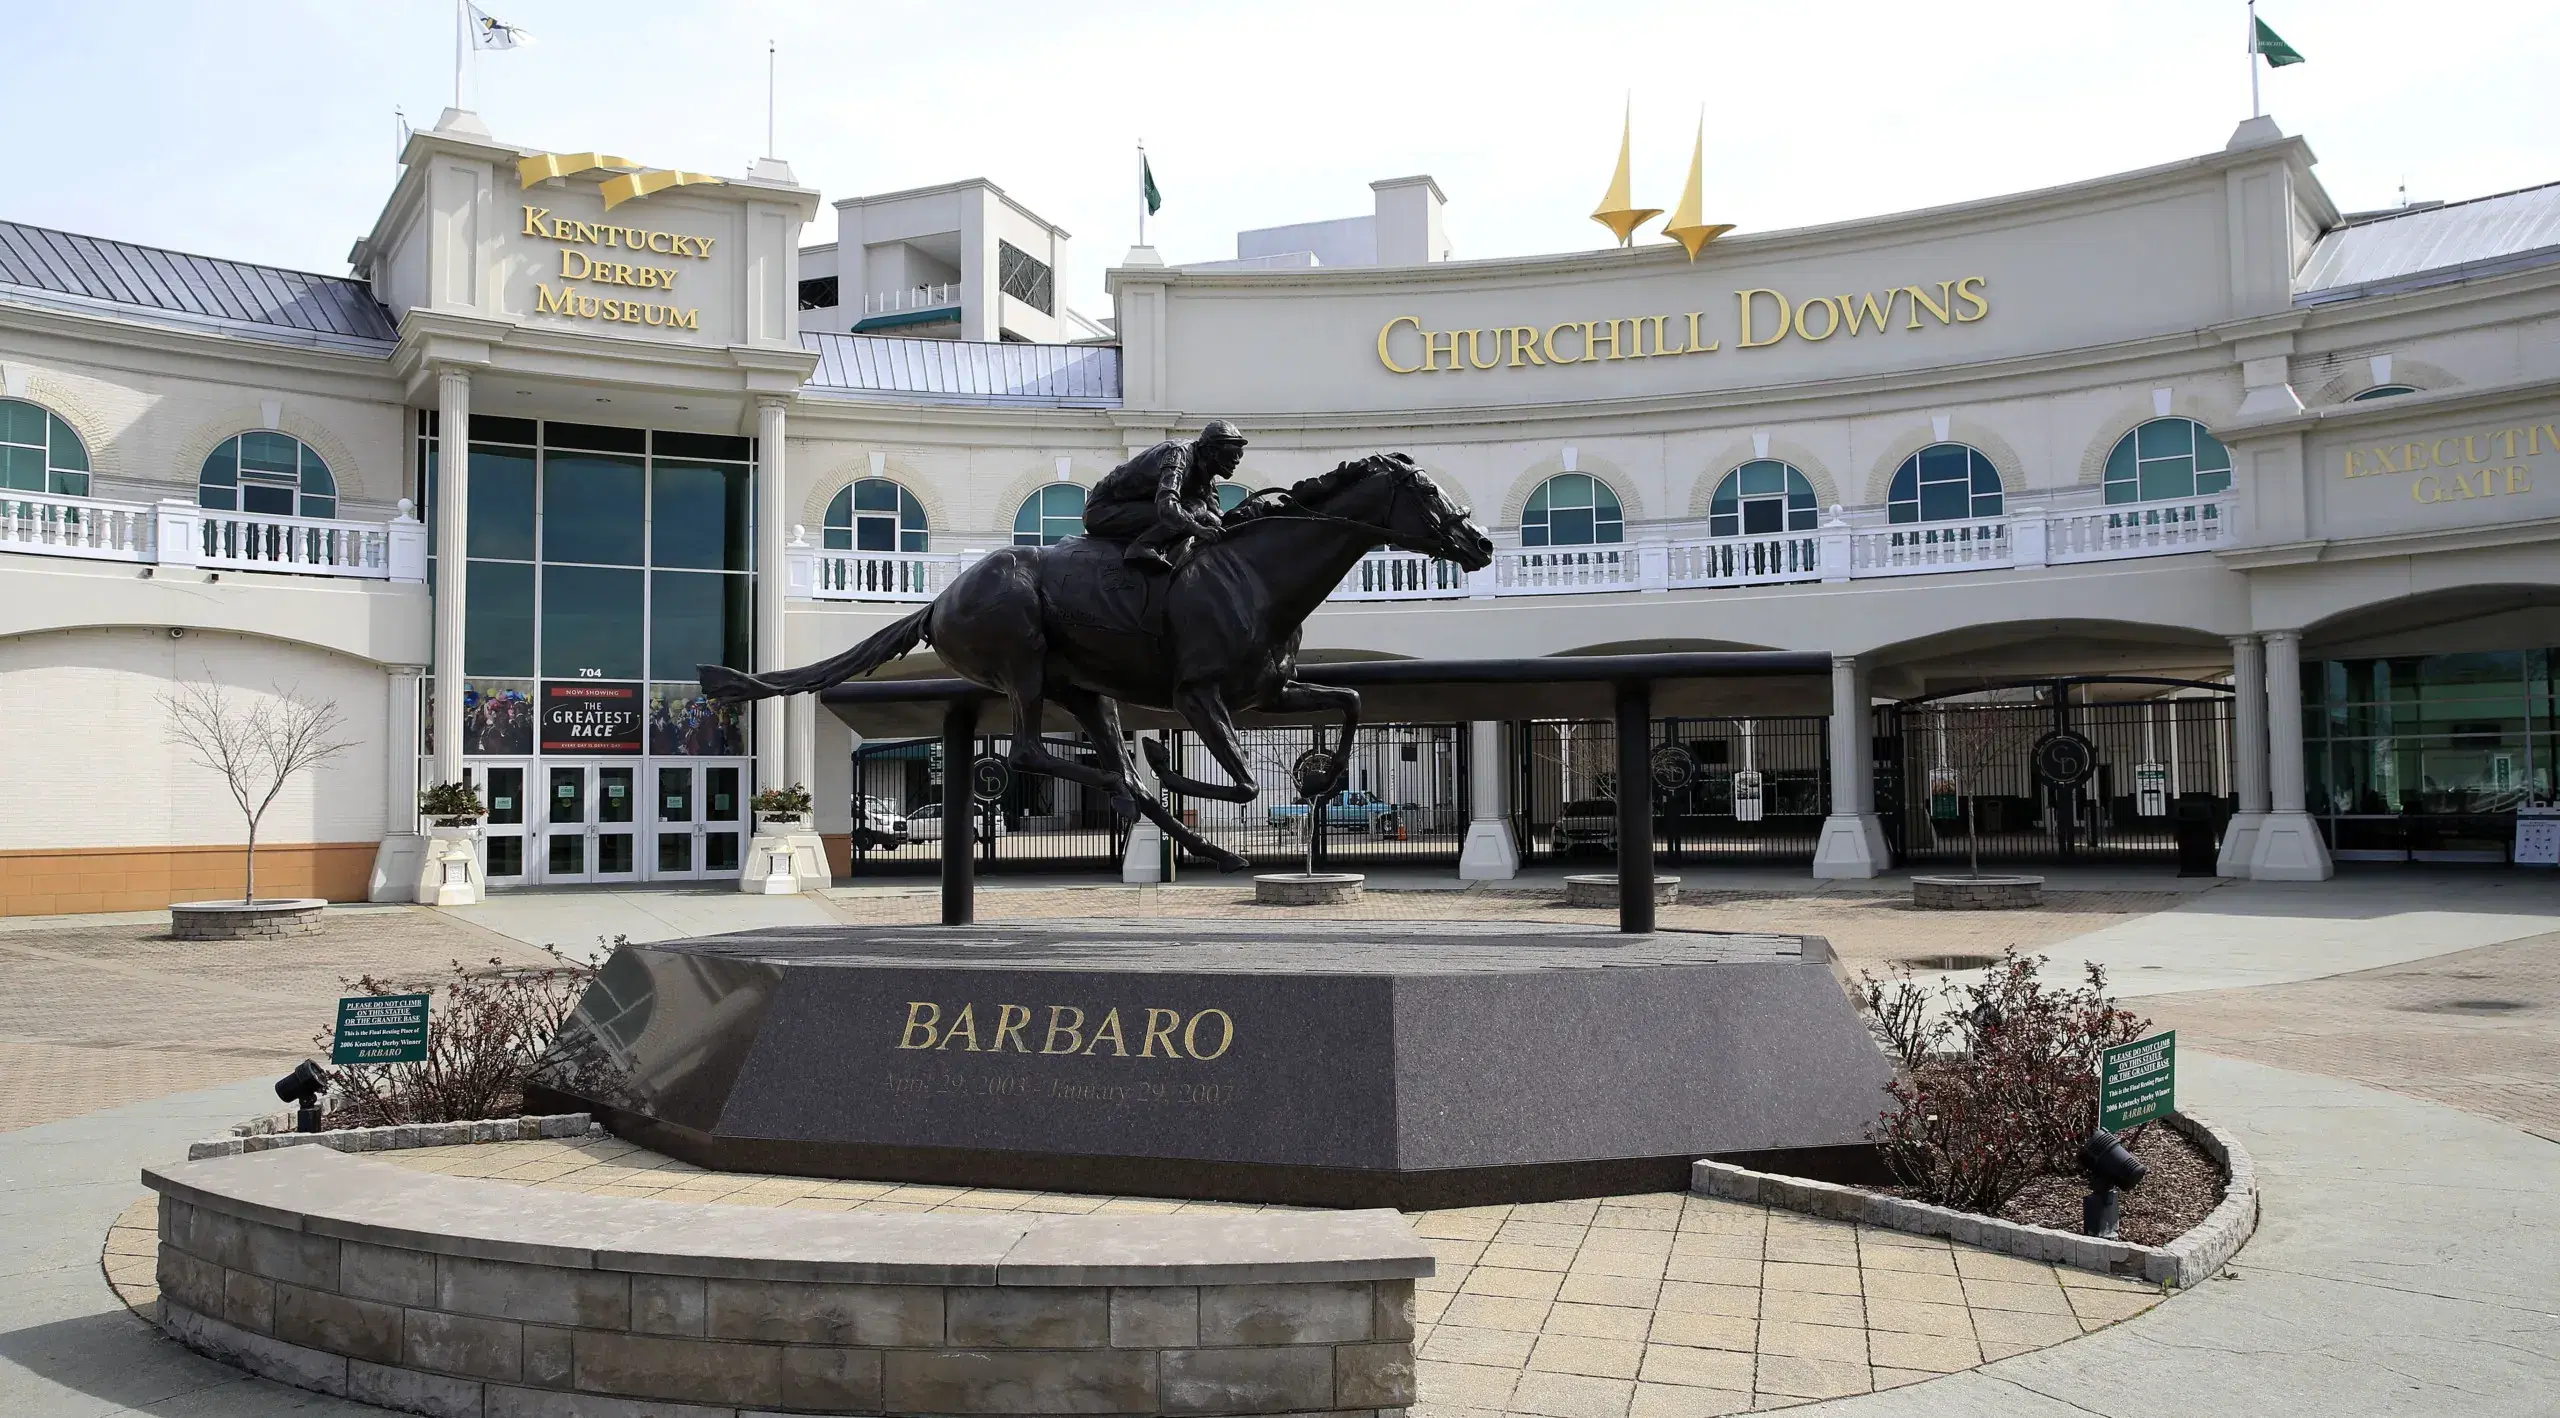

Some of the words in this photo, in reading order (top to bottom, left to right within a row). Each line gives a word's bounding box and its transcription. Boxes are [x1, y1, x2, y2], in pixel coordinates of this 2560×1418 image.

[521, 204, 715, 258] KENTUCKY
[559, 247, 678, 290] DERBY
[535, 282, 699, 329] MUSEUM
[1376, 314, 1720, 373] CHURCHILL
[1734, 275, 1989, 349] DOWNS
[2411, 464, 2533, 504] GATE
[579, 668, 602, 677] 704
[552, 711, 632, 724] GREATEST
[584, 702, 602, 710] THE
[571, 724, 614, 737] RACE
[895, 1001, 1235, 1061] BARBARO
[354, 1040, 380, 1048] Kentucky
[359, 1048, 402, 1057] BARBARO
[2110, 1051, 2132, 1063] PLEASE
[2132, 1048, 2141, 1056] DO
[2142, 1044, 2153, 1053] NOT
[2154, 1039, 2170, 1049] CLIMB
[2109, 1074, 2119, 1083] OR
[2120, 1070, 2131, 1080] THE
[2132, 1062, 2156, 1076] GRANITE
[2157, 1058, 2170, 1068] BASE
[2119, 1062, 2128, 1070] ON
[2129, 1058, 2142, 1067] THIS
[2142, 1051, 2162, 1064] STATUE
[2109, 1090, 2118, 1098] This
[2130, 1083, 2140, 1092] Final
[2141, 1079, 2154, 1089] Resting
[2155, 1076, 2164, 1084] Place
[2106, 1104, 2118, 1113] 2006
[2118, 1098, 2140, 1110] Kentucky
[2140, 1092, 2154, 1102] Derby
[2154, 1088, 2170, 1097] Winner
[2122, 1102, 2156, 1120] BARBARO
